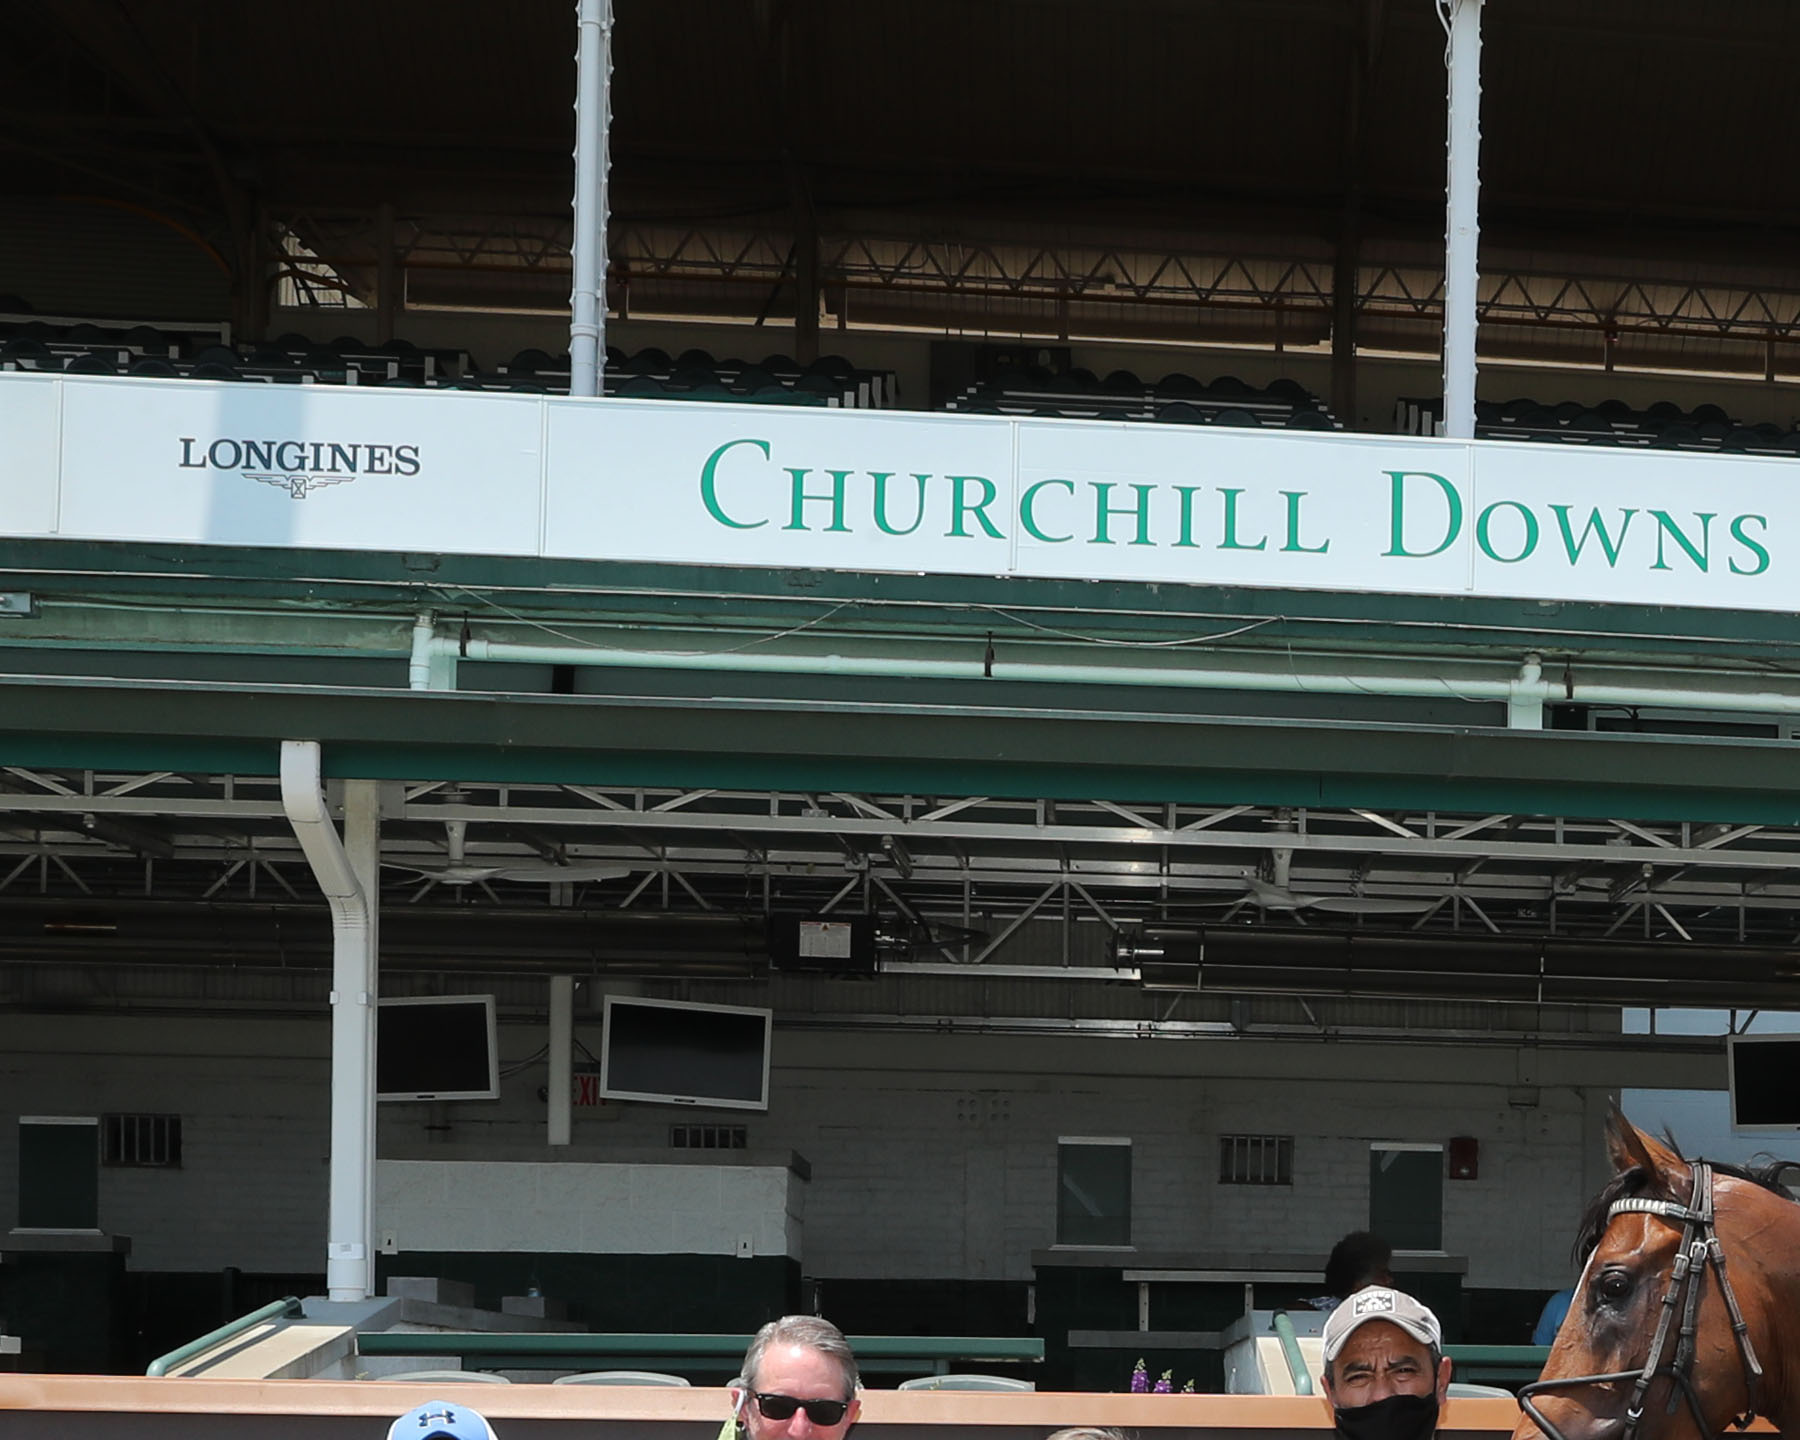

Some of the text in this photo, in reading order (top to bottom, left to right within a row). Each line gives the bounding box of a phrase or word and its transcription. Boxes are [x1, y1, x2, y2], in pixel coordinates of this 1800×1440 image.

[179, 437, 421, 476] LONGINES
[700, 438, 1771, 577] CHURCHILL DOWNS
[572, 1075, 608, 1106] XI
